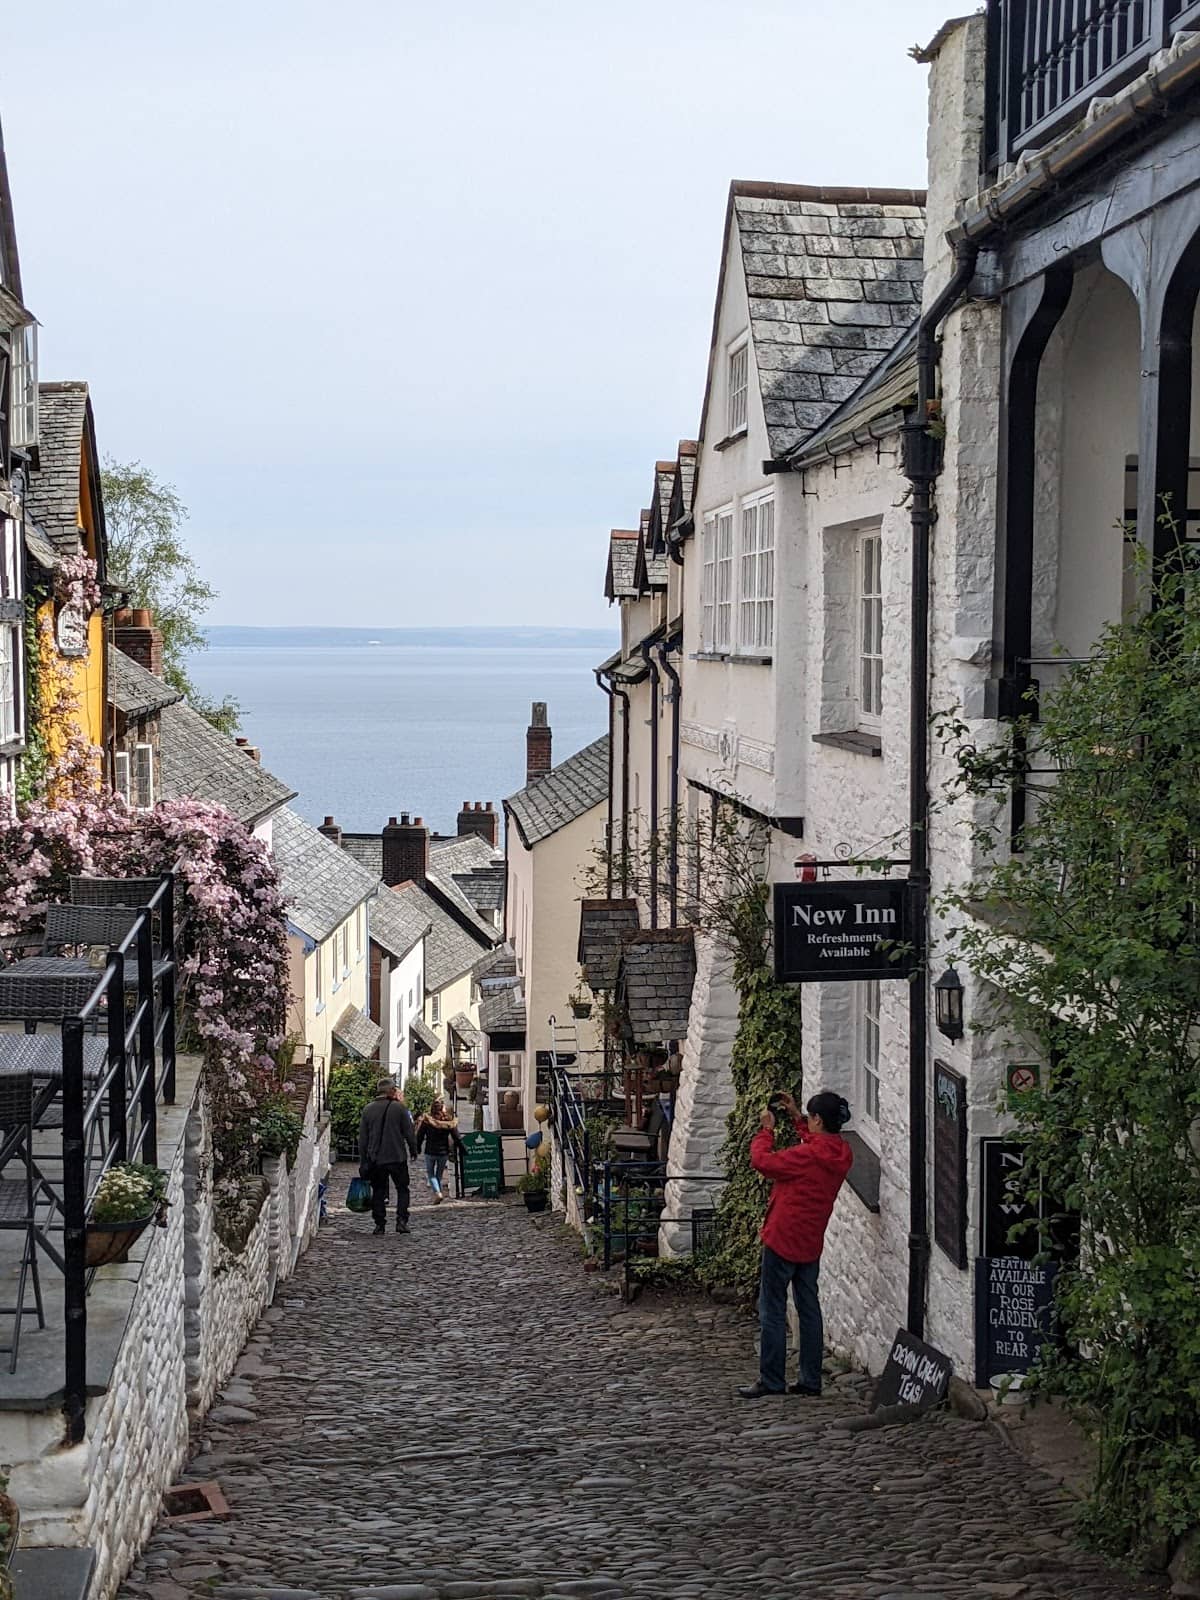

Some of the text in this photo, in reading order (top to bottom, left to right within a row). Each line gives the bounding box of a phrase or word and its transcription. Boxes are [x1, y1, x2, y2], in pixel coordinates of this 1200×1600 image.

[792, 903, 896, 926] New Inn
[807, 932, 882, 944] Refreshments
[819, 946, 871, 958] Available
[990, 1258, 1039, 1270] SEATIN
[990, 1269, 1046, 1284] AVAILABLE
[990, 1282, 1035, 1298] IN OUR
[1000, 1295, 1035, 1311] ROSE
[989, 1308, 1037, 1328] GARDEN
[1007, 1330, 1024, 1342] TO
[995, 1340, 1028, 1358] REAR
